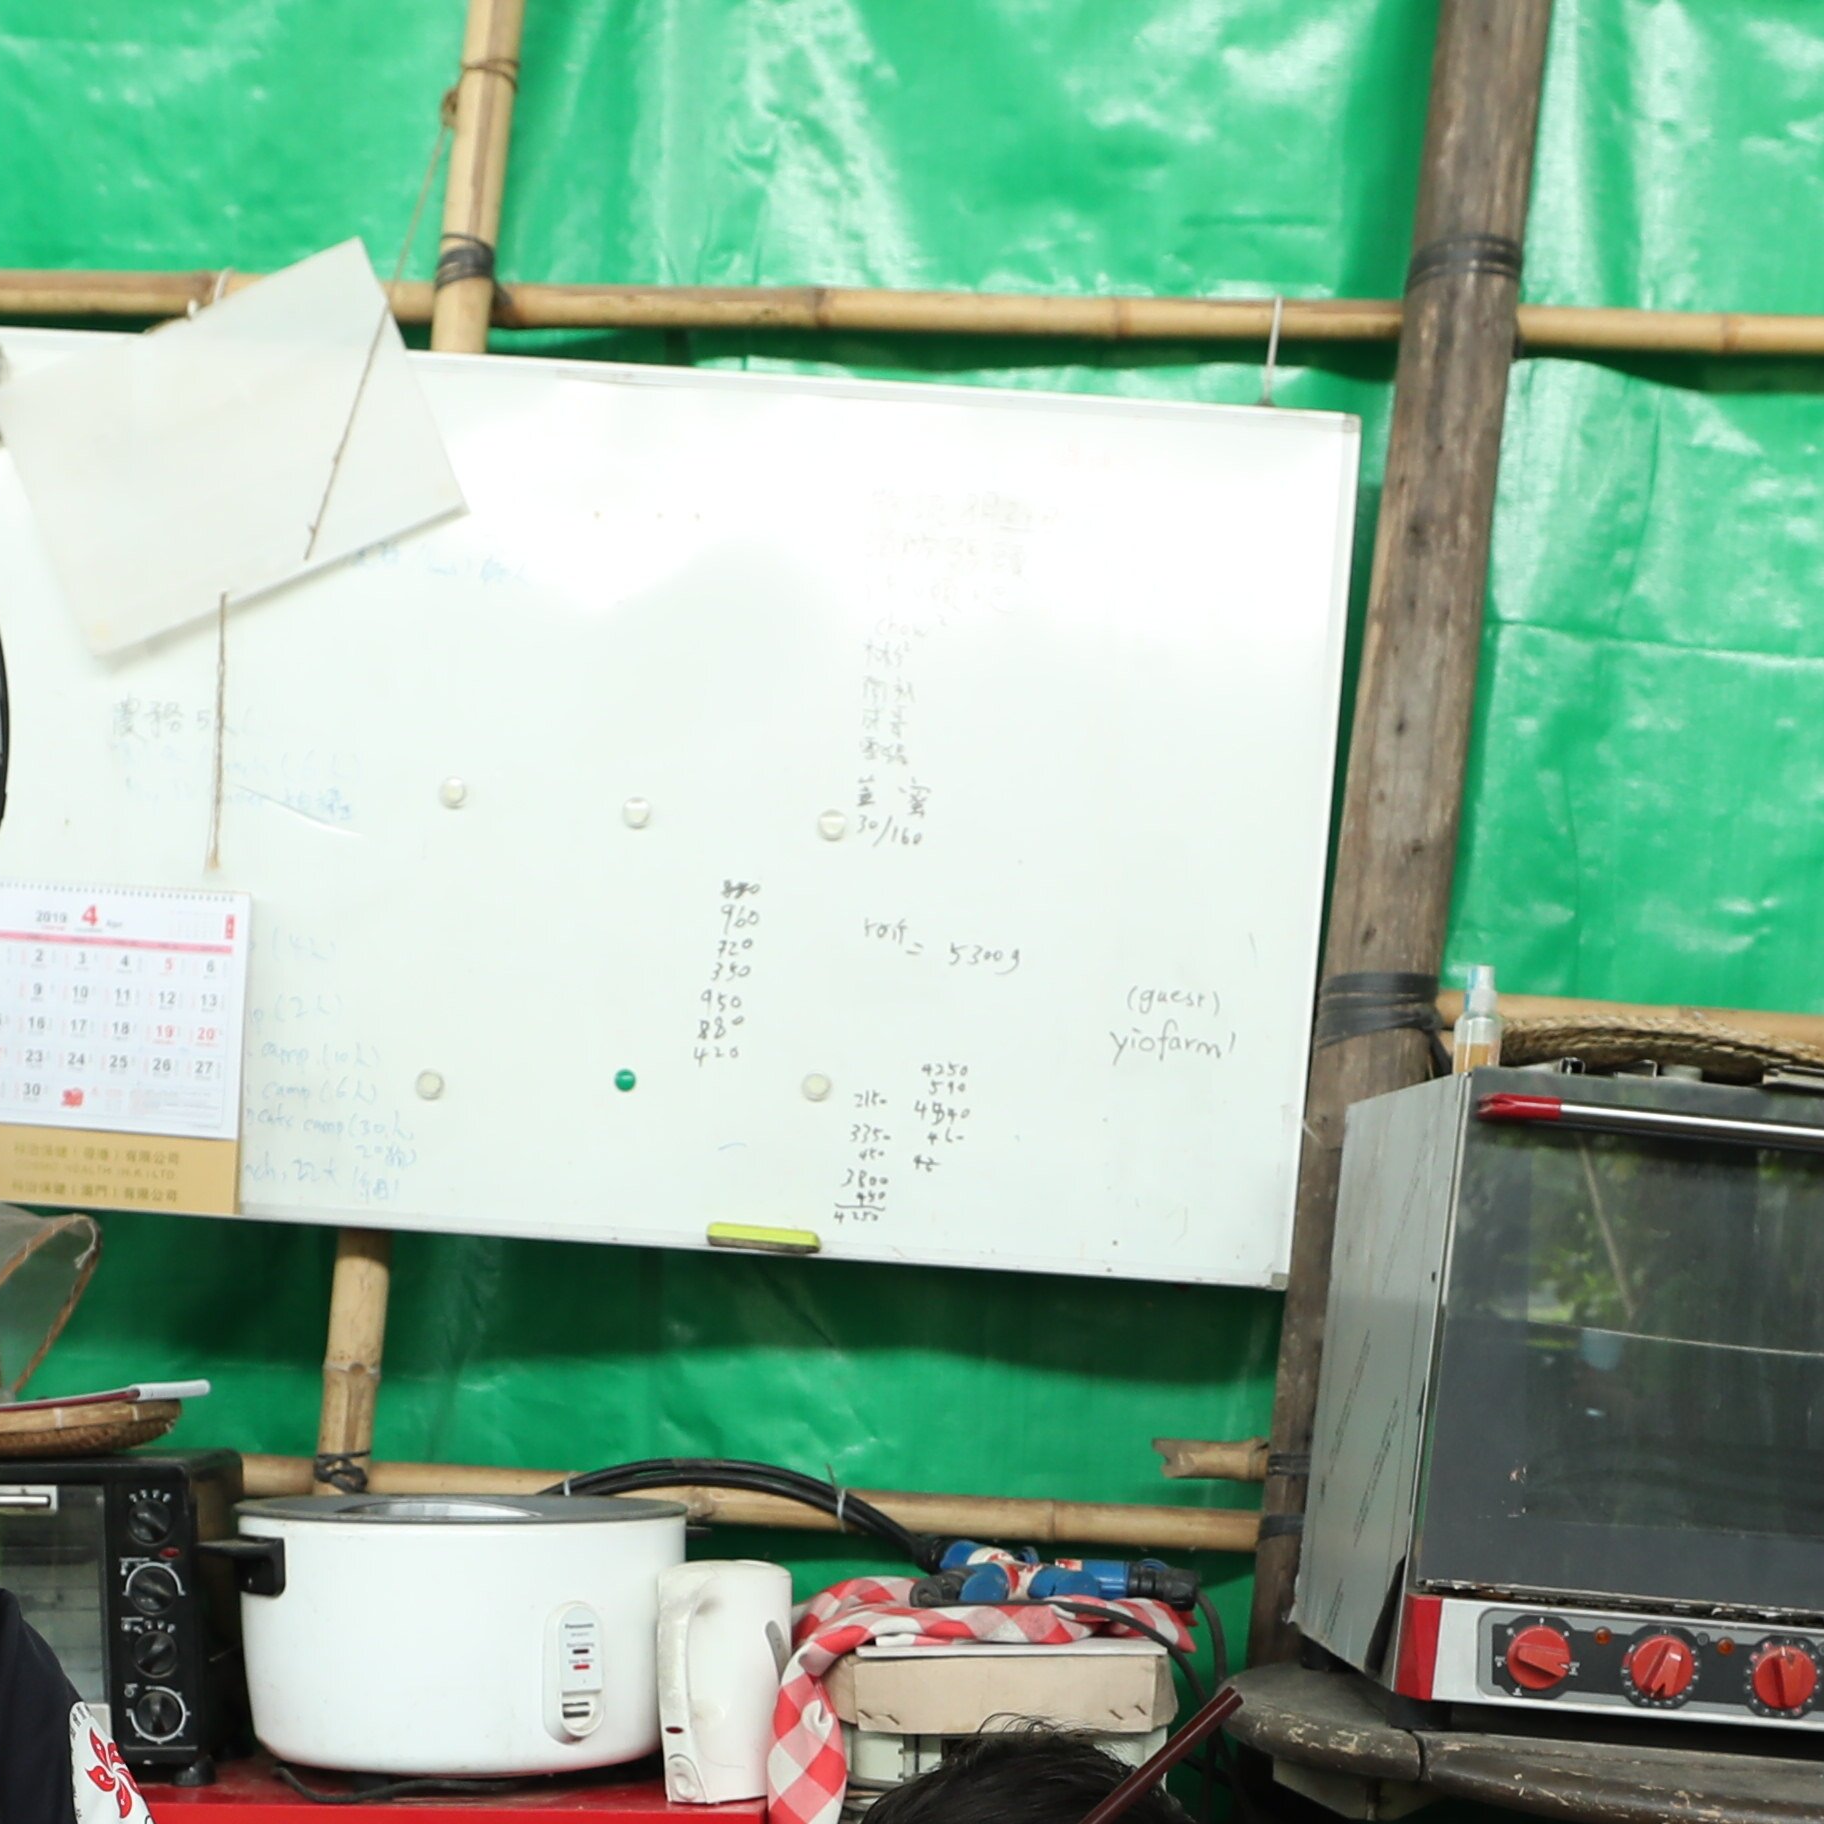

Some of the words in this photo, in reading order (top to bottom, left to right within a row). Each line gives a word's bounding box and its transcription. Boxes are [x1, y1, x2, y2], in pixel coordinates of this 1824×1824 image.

[36, 910, 68, 924] 2019
[81, 904, 98, 927] 4
[720, 903, 760, 935] 960
[72, 985, 89, 999] 10
[115, 988, 131, 1002] 11
[159, 991, 176, 1005] 12
[201, 994, 218, 1007] 13
[28, 1016, 46, 1030] 16
[70, 1019, 88, 1032] 17
[112, 1022, 130, 1035] 18
[157, 1025, 175, 1039] 19
[197, 1027, 215, 1041] 20
[25, 1049, 43, 1063] 23
[67, 1053, 85, 1066] 24
[109, 1055, 128, 1068] 25
[152, 1058, 172, 1072] 26
[194, 1060, 213, 1074] 27
[22, 1082, 41, 1096] 30
